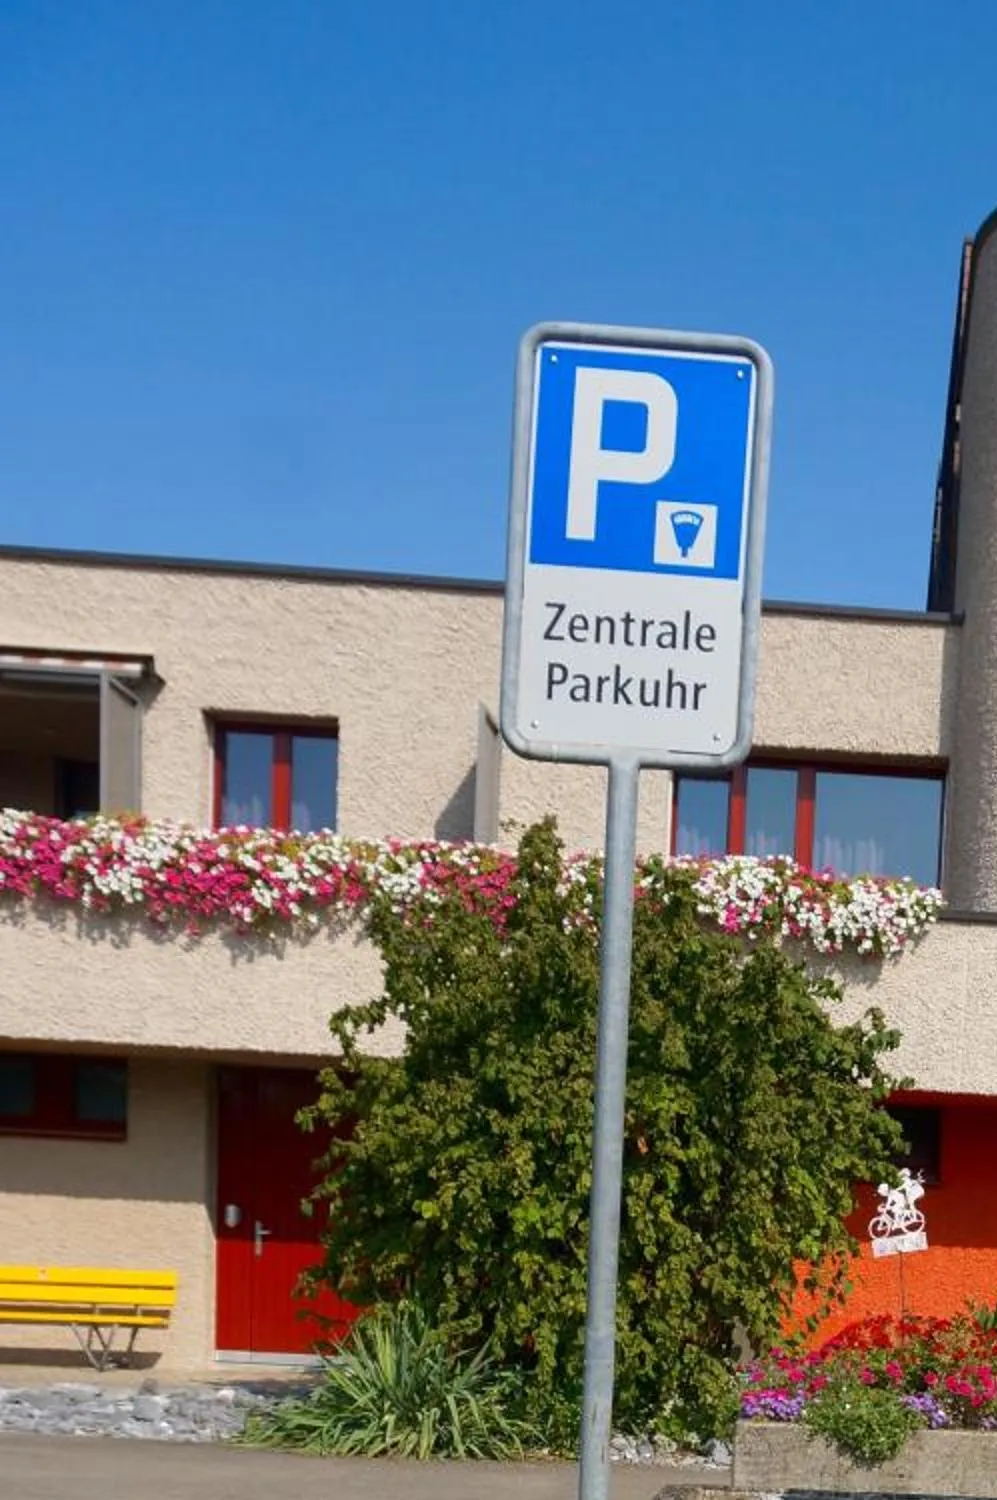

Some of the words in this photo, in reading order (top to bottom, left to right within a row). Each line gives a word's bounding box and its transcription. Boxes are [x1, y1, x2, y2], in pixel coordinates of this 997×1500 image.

[565, 366, 679, 541] P
[543, 602, 717, 653] Zentrale
[546, 662, 708, 711] Parkuhr
